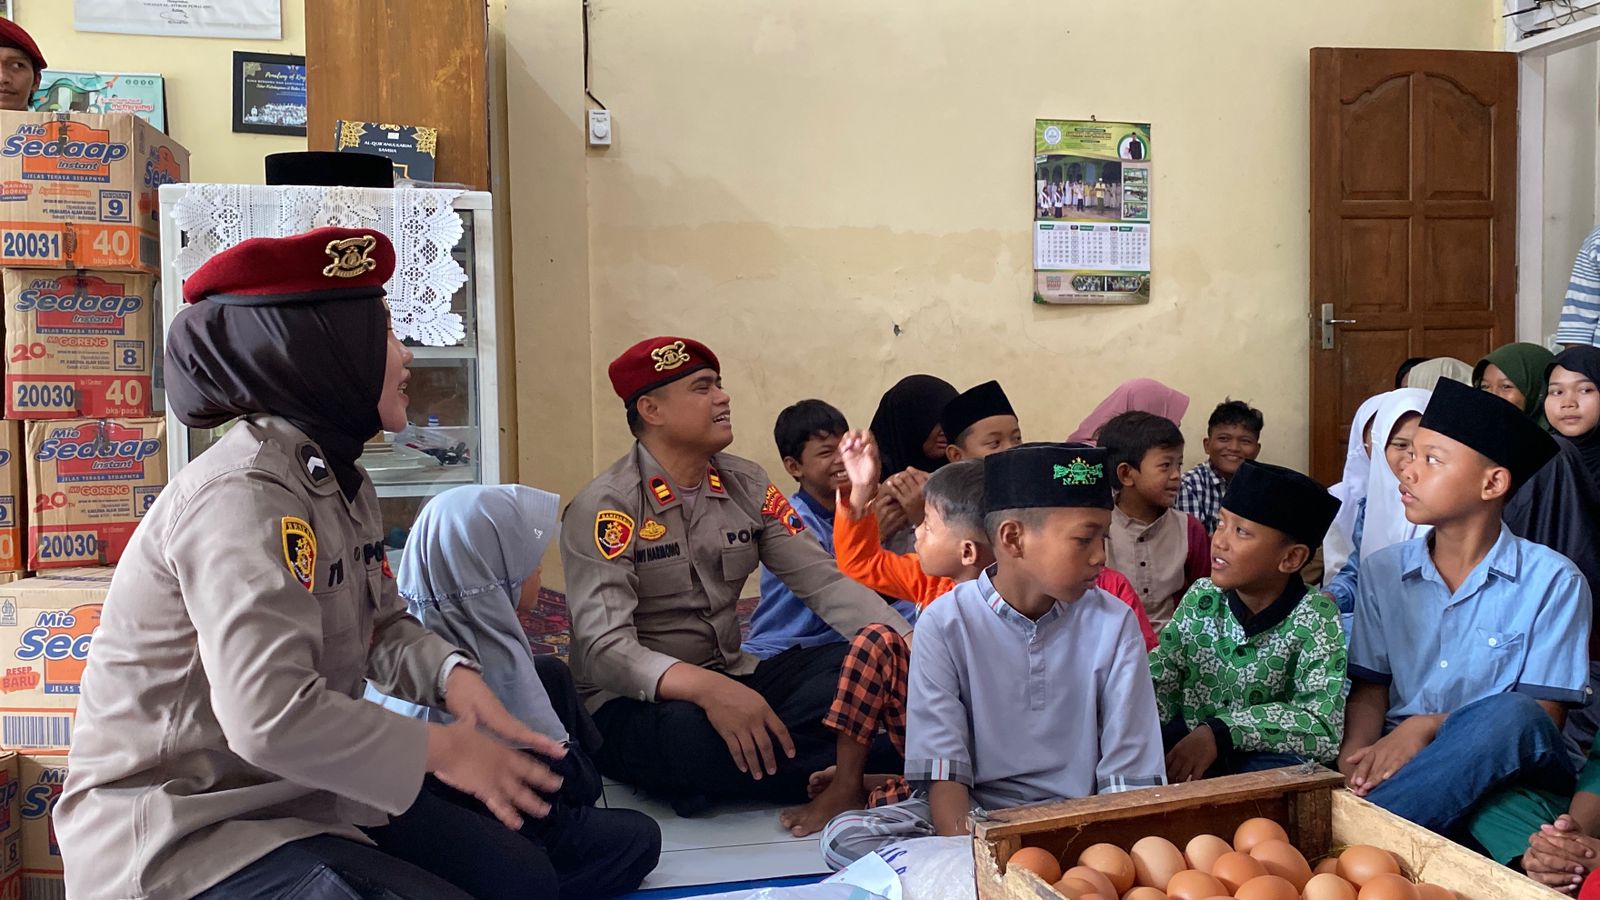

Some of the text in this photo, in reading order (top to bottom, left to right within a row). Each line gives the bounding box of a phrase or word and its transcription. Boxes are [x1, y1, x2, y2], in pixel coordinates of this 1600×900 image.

[18, 125, 46, 135] Mie
[2, 135, 128, 164] Sedaap
[58, 160, 99, 170] Instant
[108, 199, 123, 216] 9
[4, 232, 59, 257] 20031
[93, 230, 130, 256] 40
[31, 280, 60, 290] Mie
[15, 290, 143, 317] Sedaap
[60, 336, 108, 347] GORENG
[123, 348, 137, 364] 8
[18, 385, 74, 407] 20030
[106, 379, 143, 406] 40
[52, 428, 80, 439] Mie
[35, 438, 160, 461] Sedaap
[92, 460, 133, 470] Instant
[81, 485, 129, 496] GORENG
[41, 534, 97, 558] 20030
[37, 612, 75, 627] Mie
[6, 666, 32, 676] RESEP
[3, 676, 36, 688] BARU
[40, 768, 67, 784] Mi
